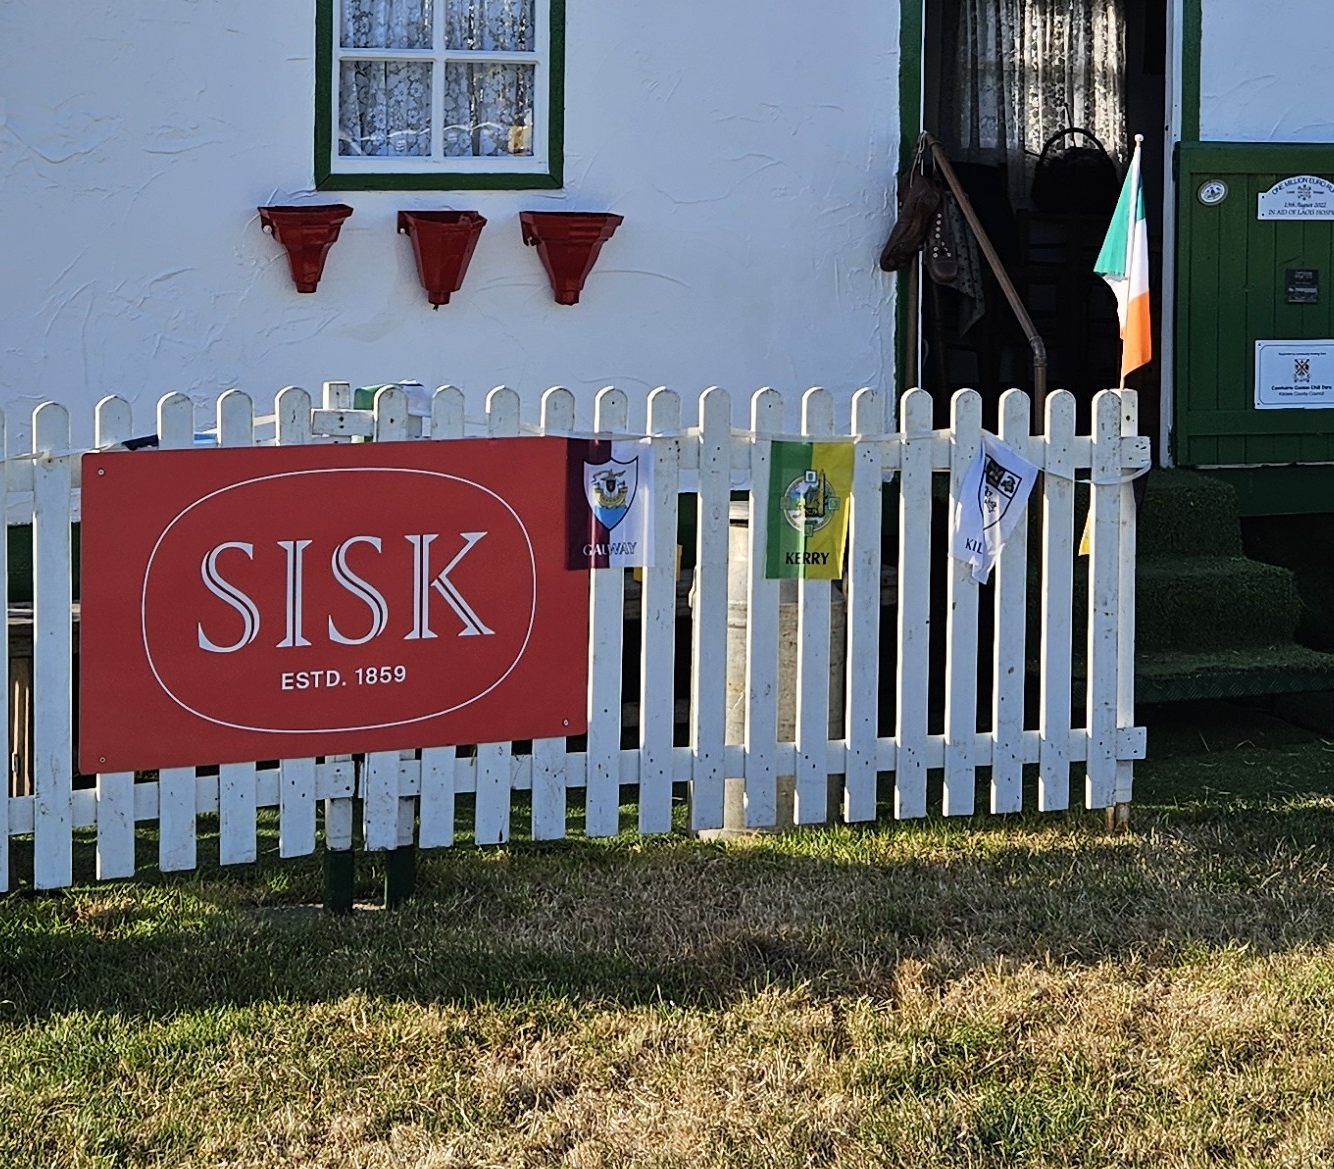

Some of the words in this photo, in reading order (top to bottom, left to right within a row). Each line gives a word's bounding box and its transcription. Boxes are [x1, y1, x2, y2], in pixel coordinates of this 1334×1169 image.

[1272, 185, 1284, 195] ONE
[1285, 178, 1308, 186] MILLION
[1309, 178, 1326, 187] EURO
[582, 541, 638, 556] GALWAY
[785, 551, 830, 565] KERRY
[197, 531, 497, 654] SISK
[281, 669, 347, 691] ESTD.
[354, 664, 407, 686] 1859
